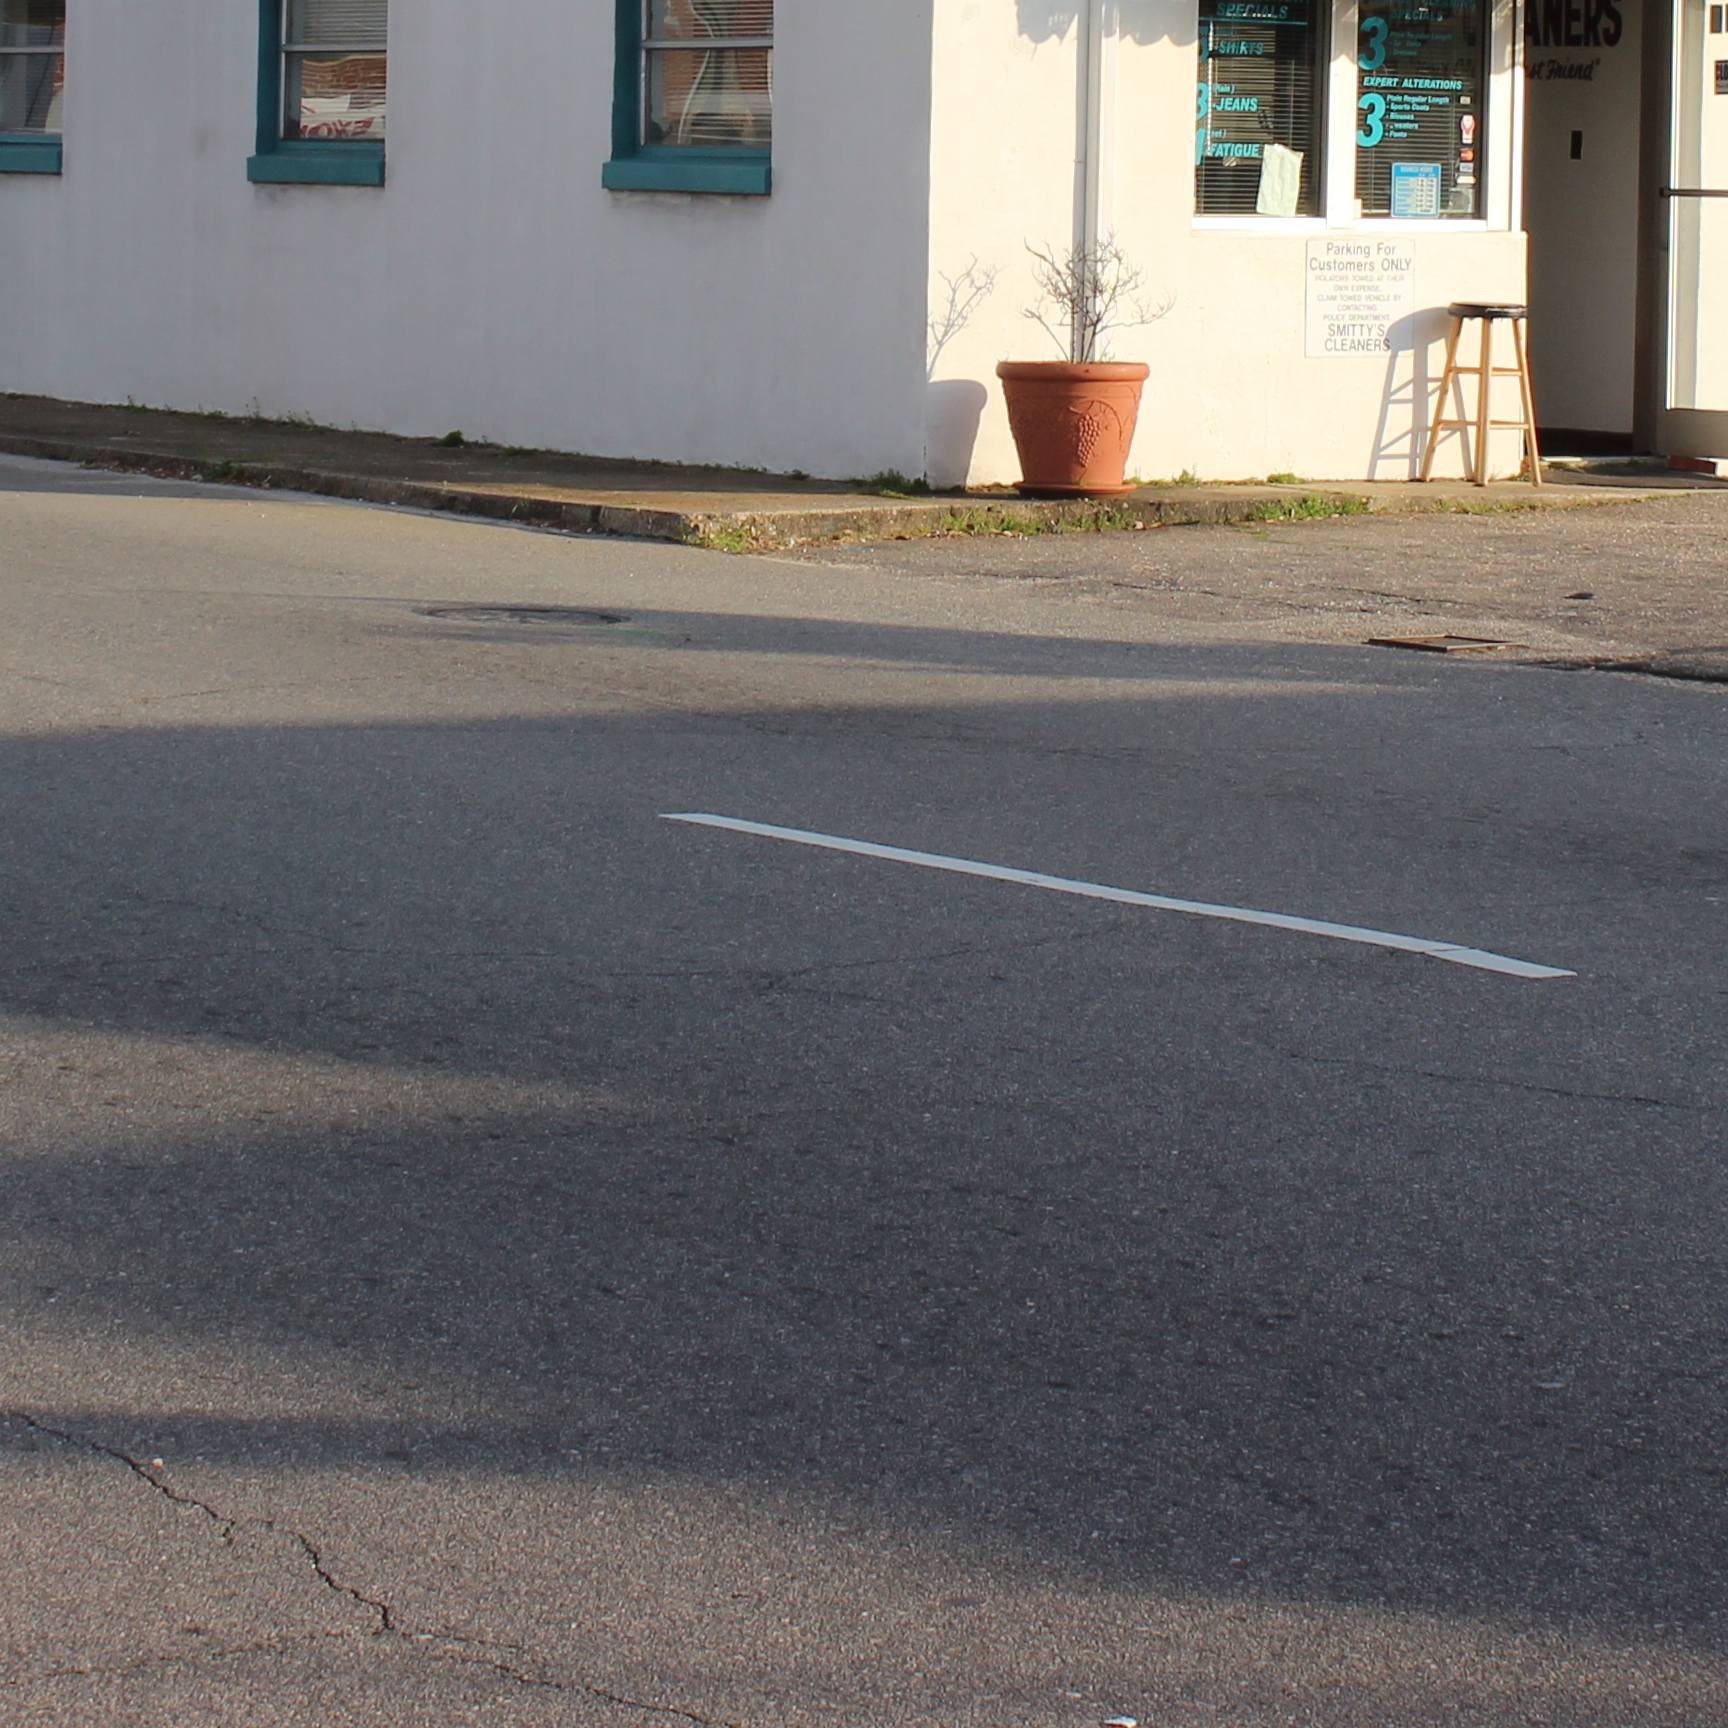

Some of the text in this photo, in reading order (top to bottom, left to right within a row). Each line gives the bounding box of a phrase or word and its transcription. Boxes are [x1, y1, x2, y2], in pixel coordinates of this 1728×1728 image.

[1216, 2, 1289, 19] SPECIALS
[1391, 8, 1443, 22] SPECIALS
[1358, 16, 1388, 70] 3
[1363, 76, 1463, 90] EXPERT ALTERATIONS
[1357, 93, 1386, 147] 3
[1327, 242, 1396, 258] Parking For
[1309, 257, 1412, 271] Customers ONLY
[1317, 294, 1402, 302] CLAIM TOWED VEHICLE BY
[1337, 304, 1377, 312] CONTACTING
[1327, 323, 1385, 337] SMITTY'S
[1325, 338, 1390, 352] CLEANERS
